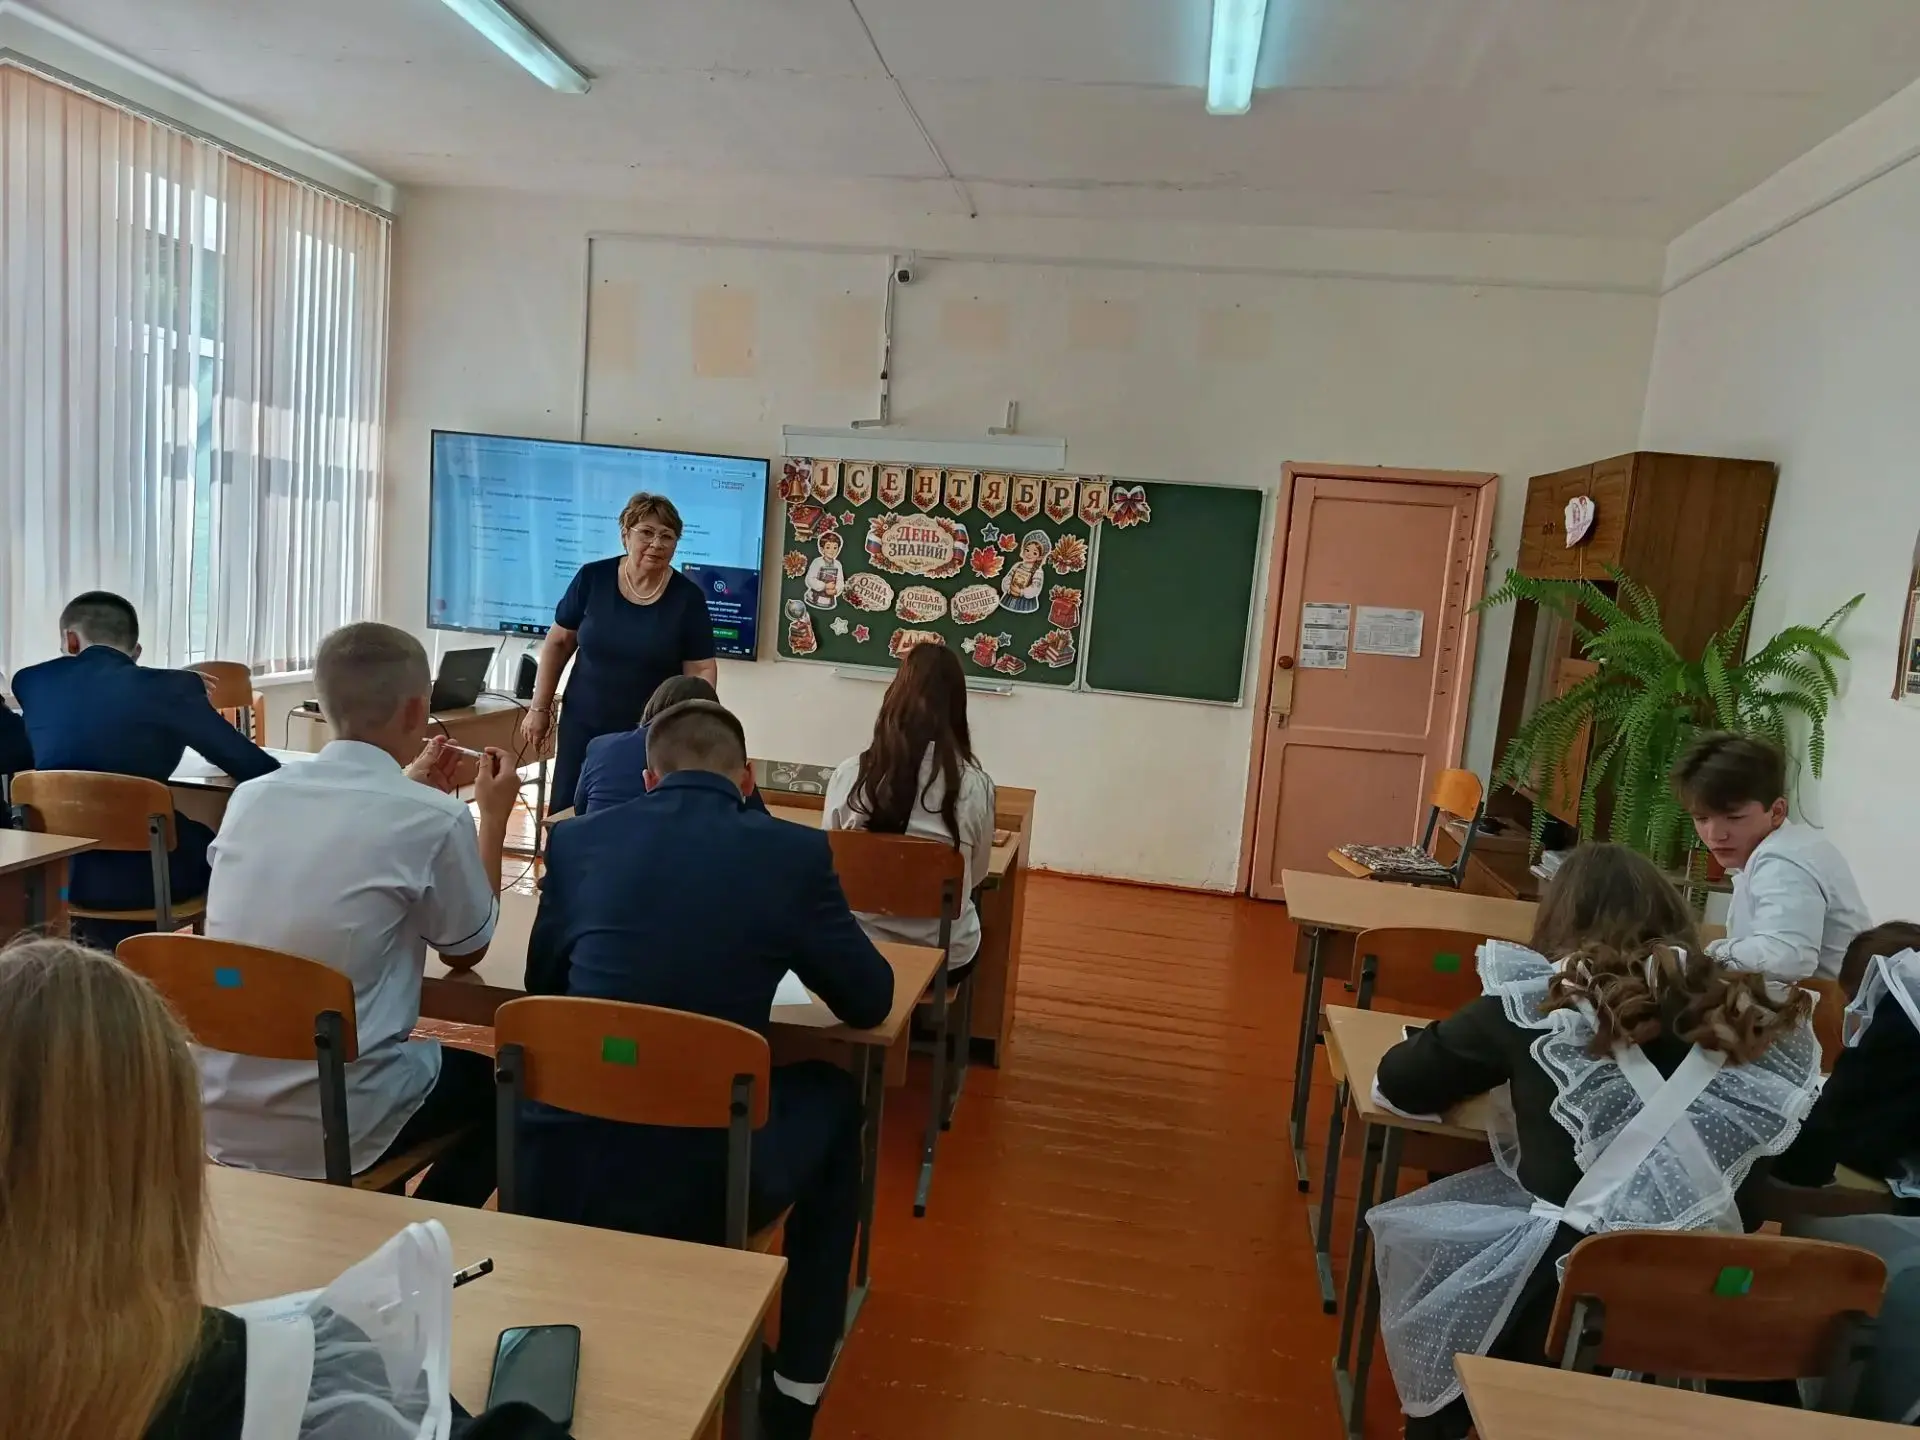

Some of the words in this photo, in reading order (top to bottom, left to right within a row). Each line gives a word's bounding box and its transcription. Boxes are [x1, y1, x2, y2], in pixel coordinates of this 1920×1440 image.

[820, 467, 829, 486] 1
[852, 470, 1102, 508] СЕНТЯБРЯ
[897, 526, 940, 543] ДЕНЬ
[889, 542, 948, 560] ЗНАНИЙ!
[853, 583, 886, 606] СТРАНА
[860, 577, 887, 596] ОДНА
[907, 592, 939, 603] ОБЩАЯ
[959, 590, 991, 604] ОБЩЕЕ
[960, 596, 997, 610] БУДУЩЕЕ
[906, 601, 942, 612] ИСТОРИЯ
